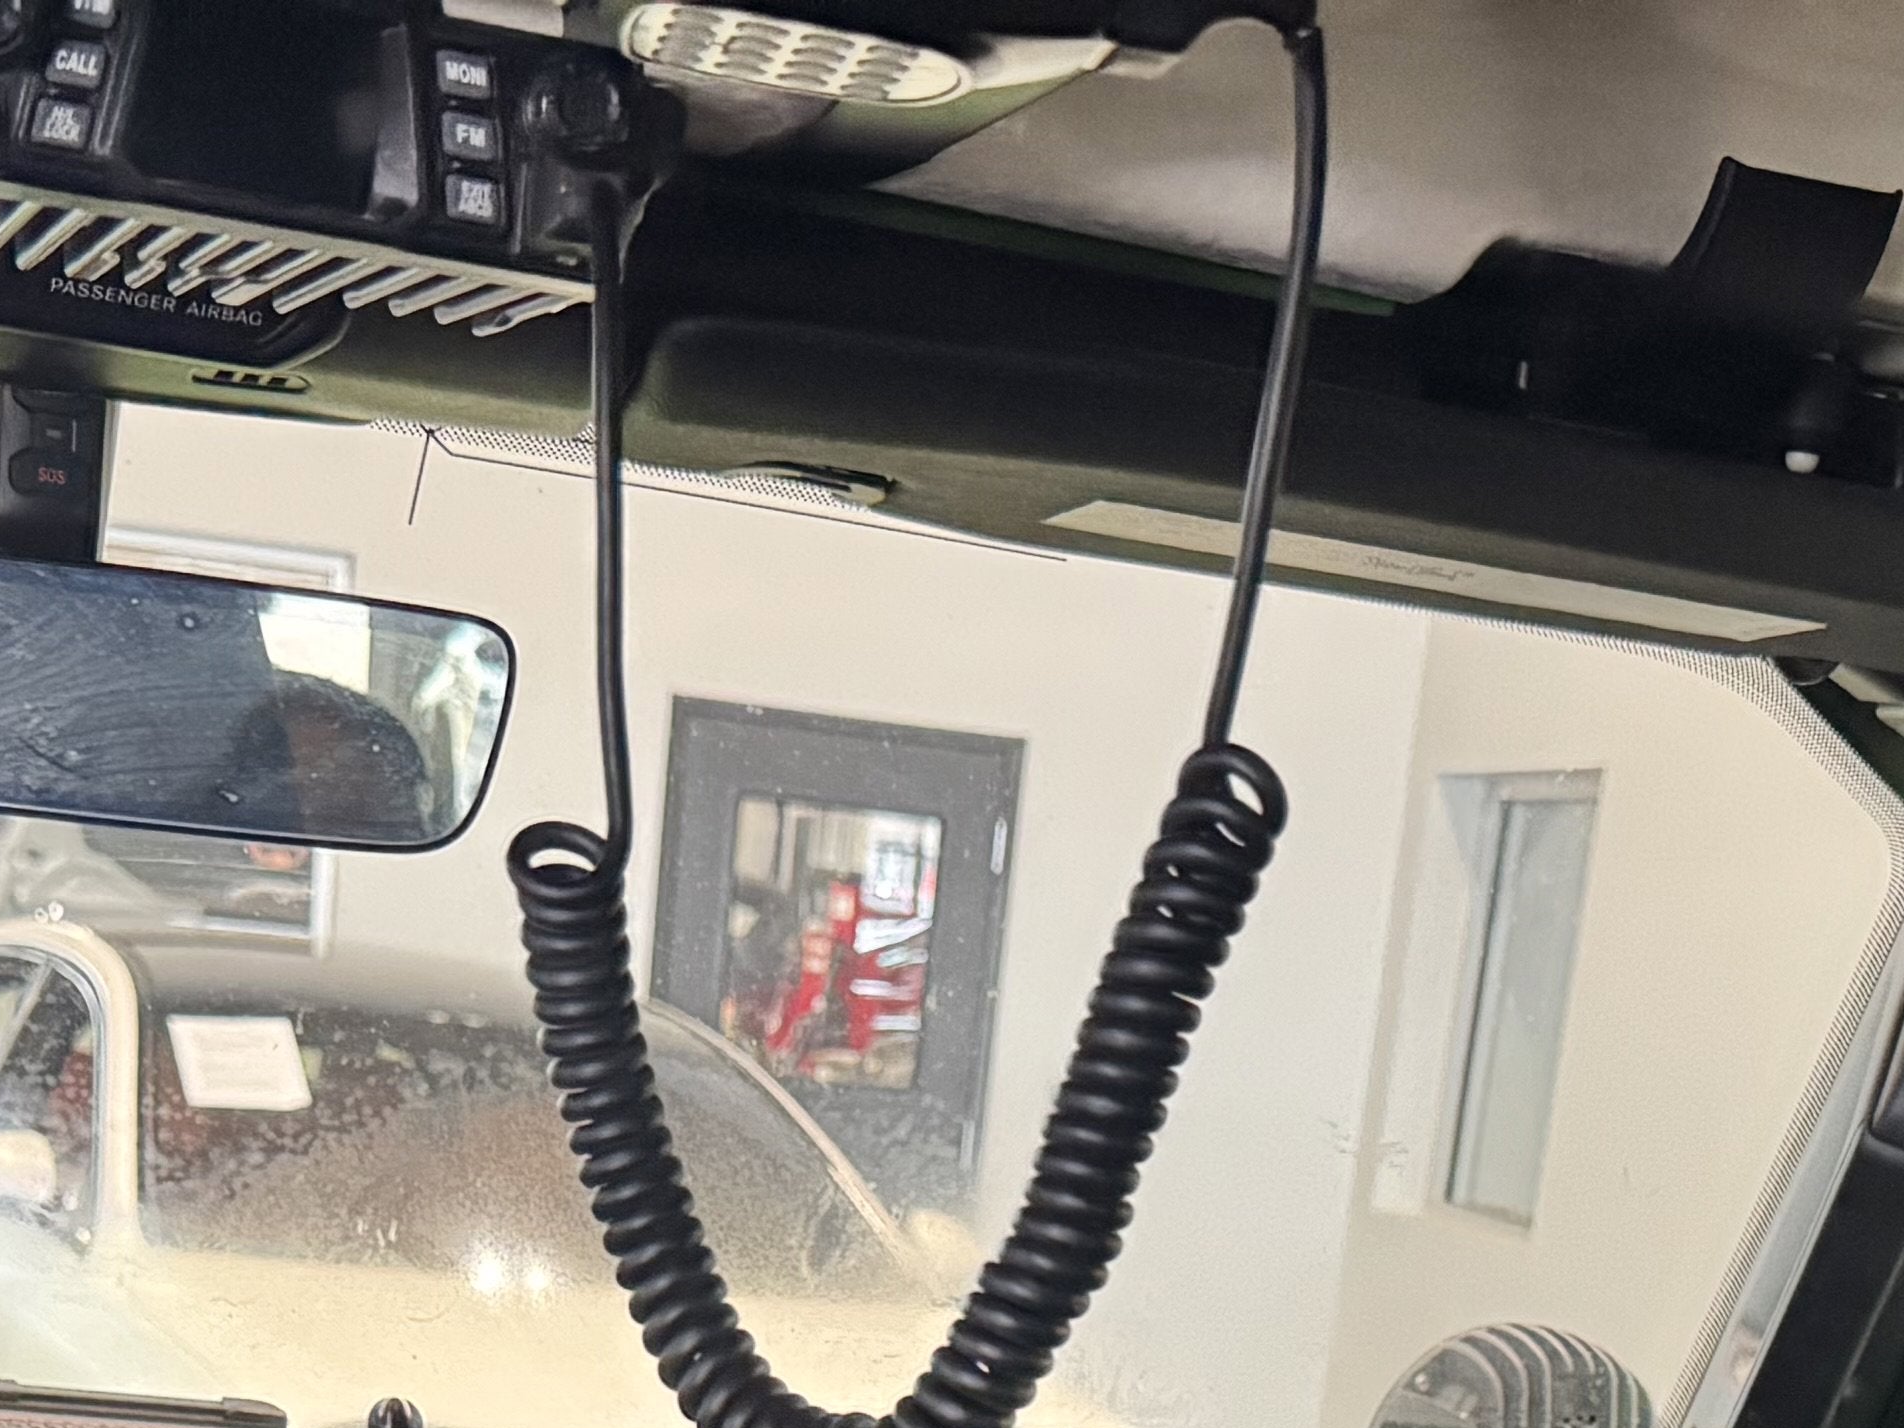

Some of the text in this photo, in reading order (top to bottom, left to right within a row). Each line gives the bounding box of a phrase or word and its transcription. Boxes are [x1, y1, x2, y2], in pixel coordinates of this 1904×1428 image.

[55, 49, 98, 77] CALL
[456, 123, 486, 148] FM
[50, 276, 264, 327] PASSENGER AIRBAG
[38, 466, 66, 485] SOS
